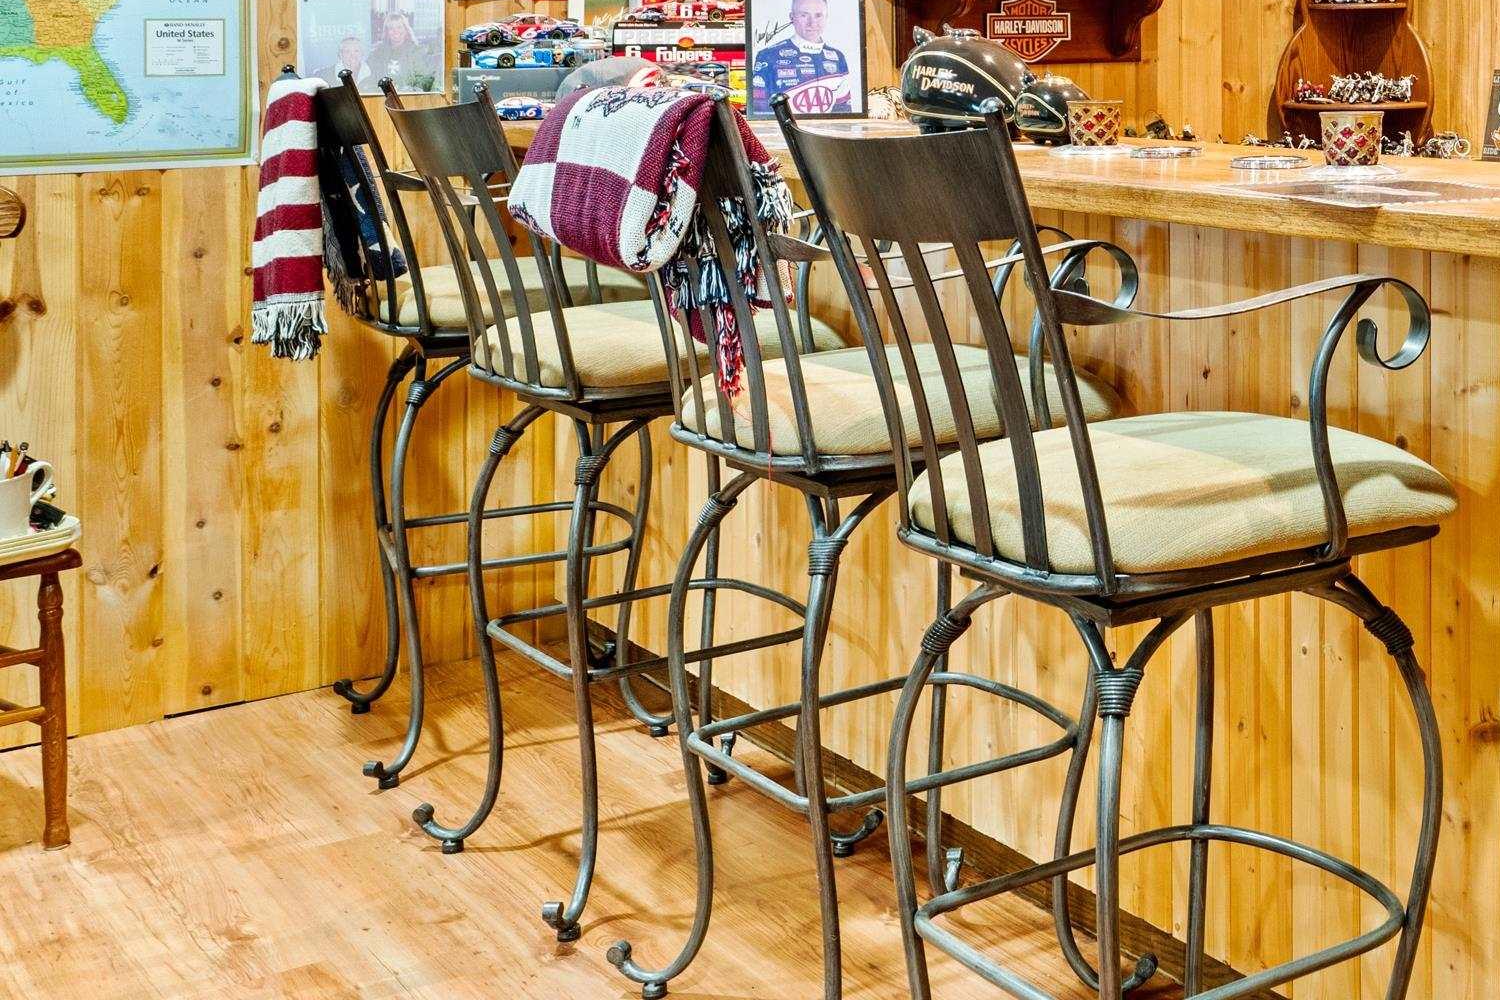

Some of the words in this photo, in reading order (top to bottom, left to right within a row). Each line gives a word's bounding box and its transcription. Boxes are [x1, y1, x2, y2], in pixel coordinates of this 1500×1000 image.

[681, 4, 693, 18] 6
[1010, 5, 1047, 15] MOTOR
[156, 30, 185, 38] United
[187, 30, 215, 38] States
[994, 20, 1064, 34] HARLEY-DAVIDSON
[625, 45, 641, 57] 6
[1010, 38, 1048, 55] CYCLES
[656, 46, 713, 64] Folgers
[921, 77, 975, 94] DAVIDSON
[1483, 147, 1499, 156] RIDE
